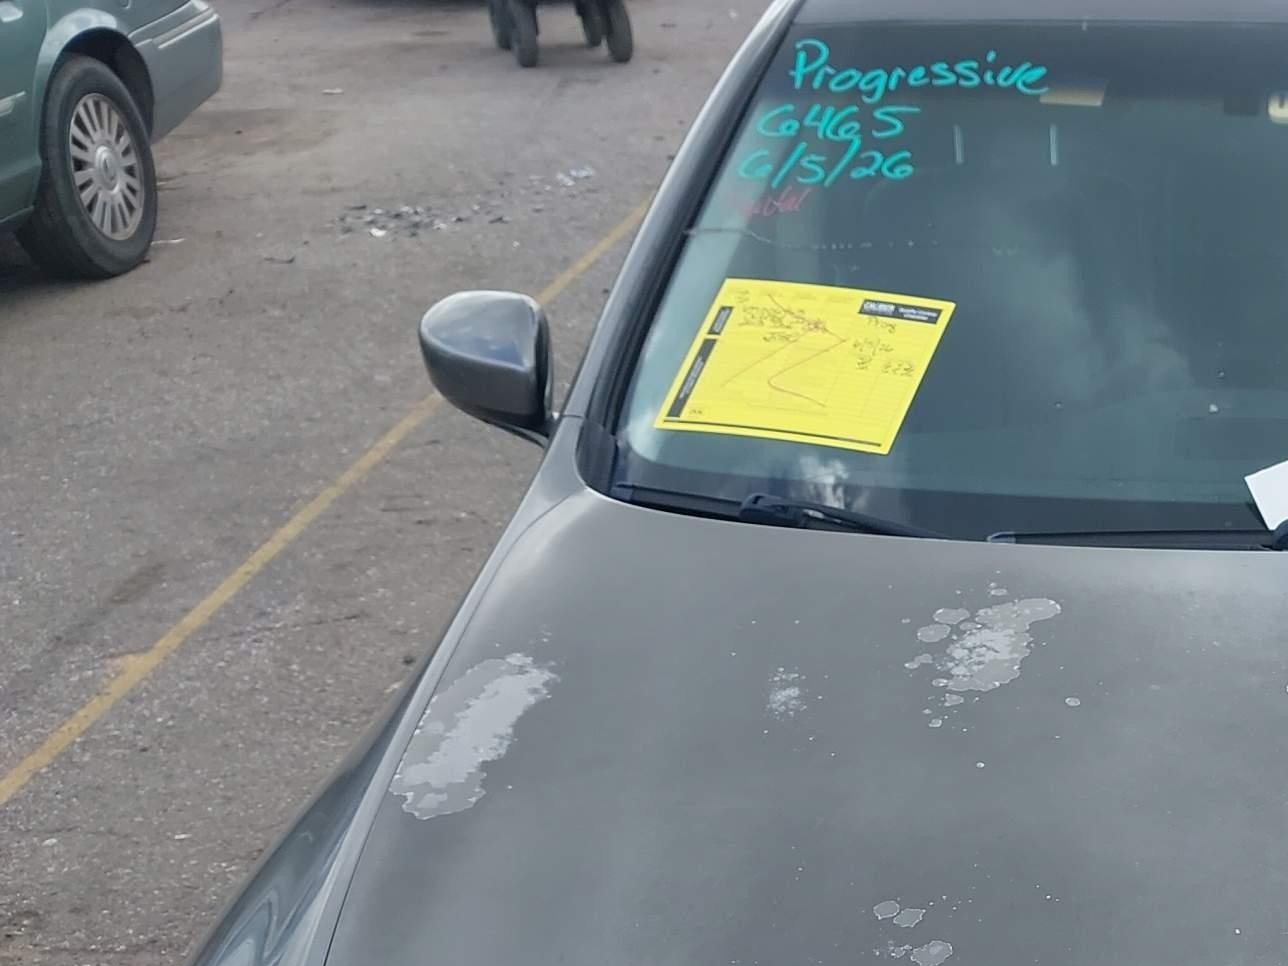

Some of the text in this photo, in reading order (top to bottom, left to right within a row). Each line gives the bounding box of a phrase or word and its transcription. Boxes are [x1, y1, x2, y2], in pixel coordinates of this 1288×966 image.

[789, 38, 1049, 103] Progressive
[756, 104, 921, 141] 6465
[737, 134, 914, 189] 6/5/26
